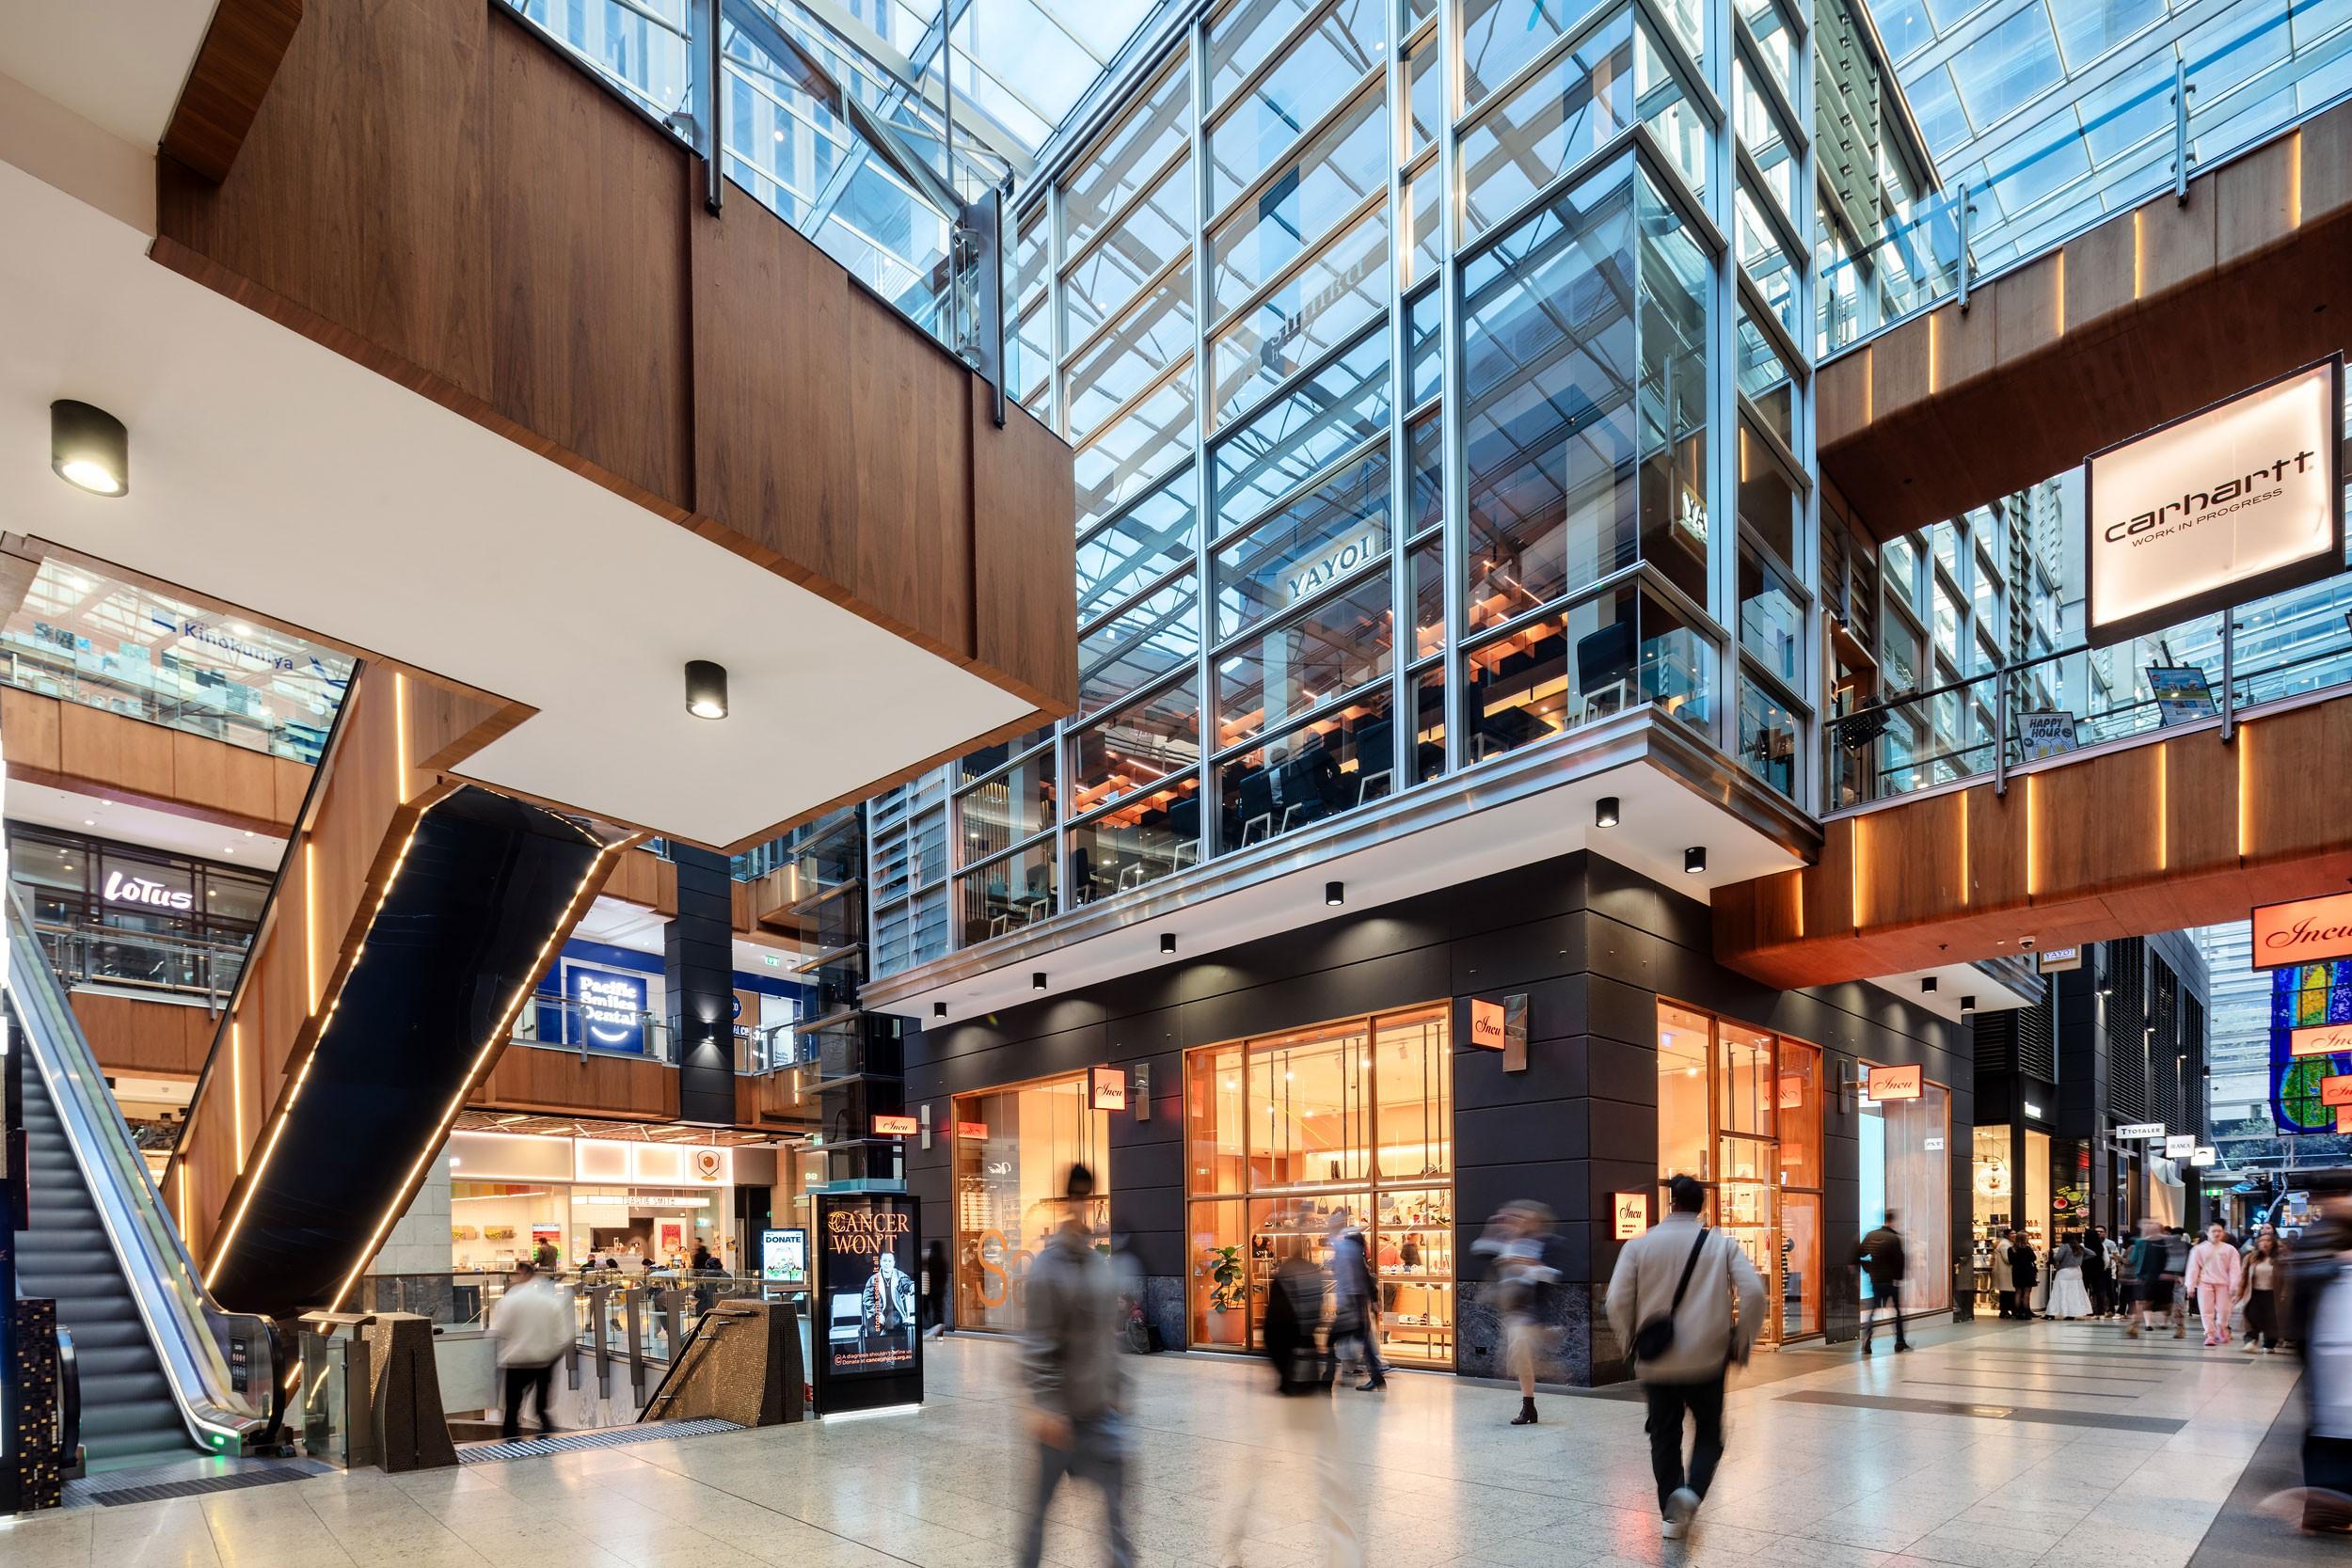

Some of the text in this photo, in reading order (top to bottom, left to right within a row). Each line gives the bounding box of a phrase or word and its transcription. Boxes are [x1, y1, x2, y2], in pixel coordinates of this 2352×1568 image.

[2105, 451, 2314, 544] carhartt
[2132, 487, 2283, 547] WORK IN PROGRESS
[1288, 534, 1372, 600] YAYOI
[184, 622, 294, 671] Kinokuniya
[2029, 718, 2063, 728] HAPPY
[2032, 727, 2061, 737] HOUR
[2045, 948, 2074, 958] YAYOI
[580, 976, 637, 999] Pacific
[580, 990, 637, 1011] Smiles
[1476, 1015, 1502, 1037] Incu
[1096, 1082, 1122, 1097] Incu
[1874, 1075, 1913, 1091] Incu
[882, 1119, 909, 1132] Incu
[1619, 1200, 1643, 1220] Incu
[828, 1211, 911, 1233] CANCER
[873, 1274, 882, 1300] seein
